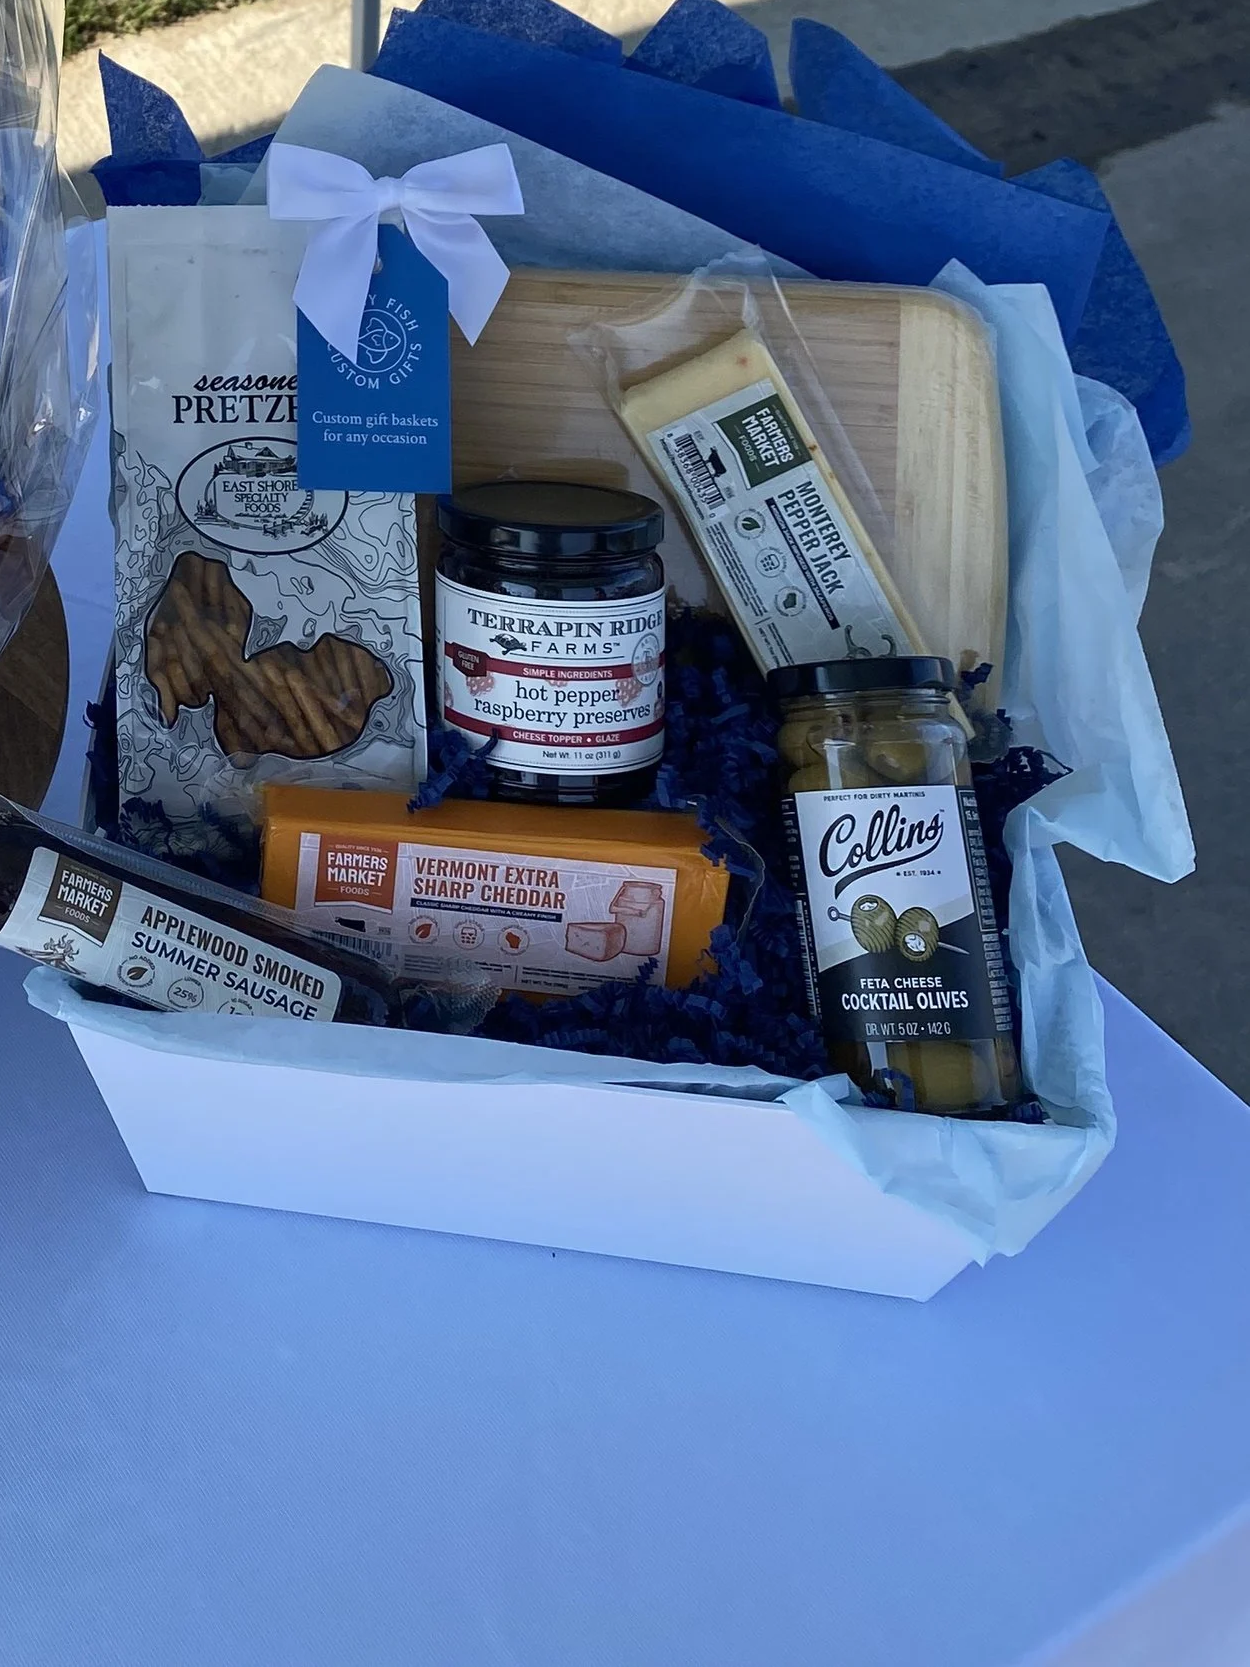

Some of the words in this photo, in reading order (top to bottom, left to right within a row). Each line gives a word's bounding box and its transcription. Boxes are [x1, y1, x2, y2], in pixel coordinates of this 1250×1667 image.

[385, 297, 419, 332] FISH
[389, 342, 423, 385] GIFTS
[193, 373, 298, 392] seasone
[171, 394, 298, 424] PRETZE
[312, 410, 362, 425] Custom
[366, 413, 389, 429] gift
[391, 413, 439, 427] baskets
[323, 429, 343, 442] for
[346, 432, 369, 446] any
[371, 433, 428, 445] occasion
[741, 415, 780, 467] MARKET
[756, 407, 794, 463] FARMERS
[738, 434, 757, 462] FOODS
[223, 481, 255, 492] EAST
[257, 480, 298, 492] SHORE
[234, 492, 289, 503] SPECIALTY
[244, 503, 281, 513] FOODS
[796, 480, 851, 561] MONTEREY
[777, 489, 821, 552] PEPPER
[810, 553, 845, 595] JACK
[467, 608, 605, 637] TERRAPIN
[610, 609, 663, 637] RIDGE
[457, 650, 480, 664] GLUTEN
[461, 660, 475, 671] FREE
[523, 667, 555, 678] SIMPLE
[557, 670, 613, 680] INGREDIENTS
[516, 680, 549, 701] hot
[555, 688, 620, 708] pepper
[474, 698, 568, 728] raspberry
[573, 703, 651, 729] preserves
[513, 731, 545, 742] CHEESE
[548, 734, 583, 744] TOPPER
[595, 734, 620, 743] GLAZE
[542, 750, 557, 758] Net
[574, 751, 582, 759] 11
[585, 752, 594, 760] oz
[870, 792, 891, 800] DIRTY
[327, 851, 388, 871] FARMERS
[327, 867, 386, 887] MARKET
[416, 856, 499, 882] VERMONT
[505, 865, 560, 889] EXTRA
[61, 869, 113, 902] FARMERS
[340, 886, 370, 896] FOODS
[413, 877, 475, 899] SHARP
[480, 884, 567, 910] CHEDDAR
[57, 884, 108, 917] MARKET
[65, 906, 91, 923] FOODS
[140, 905, 249, 968] APPLEWOOD
[253, 953, 325, 1000] SMOKED
[131, 931, 221, 982] SUMMER
[223, 971, 318, 1022] SAUSAGE
[860, 978, 890, 989] FETA
[894, 976, 942, 989] CHEESE
[173, 987, 198, 1003] 25%
[841, 992, 914, 1011] COCKTAIL
[916, 990, 969, 1010] OLIVES
[898, 1022, 906, 1035] 5
[906, 1022, 919, 1036] OZ
[927, 1022, 942, 1035] 142
[943, 1021, 951, 1035] G
